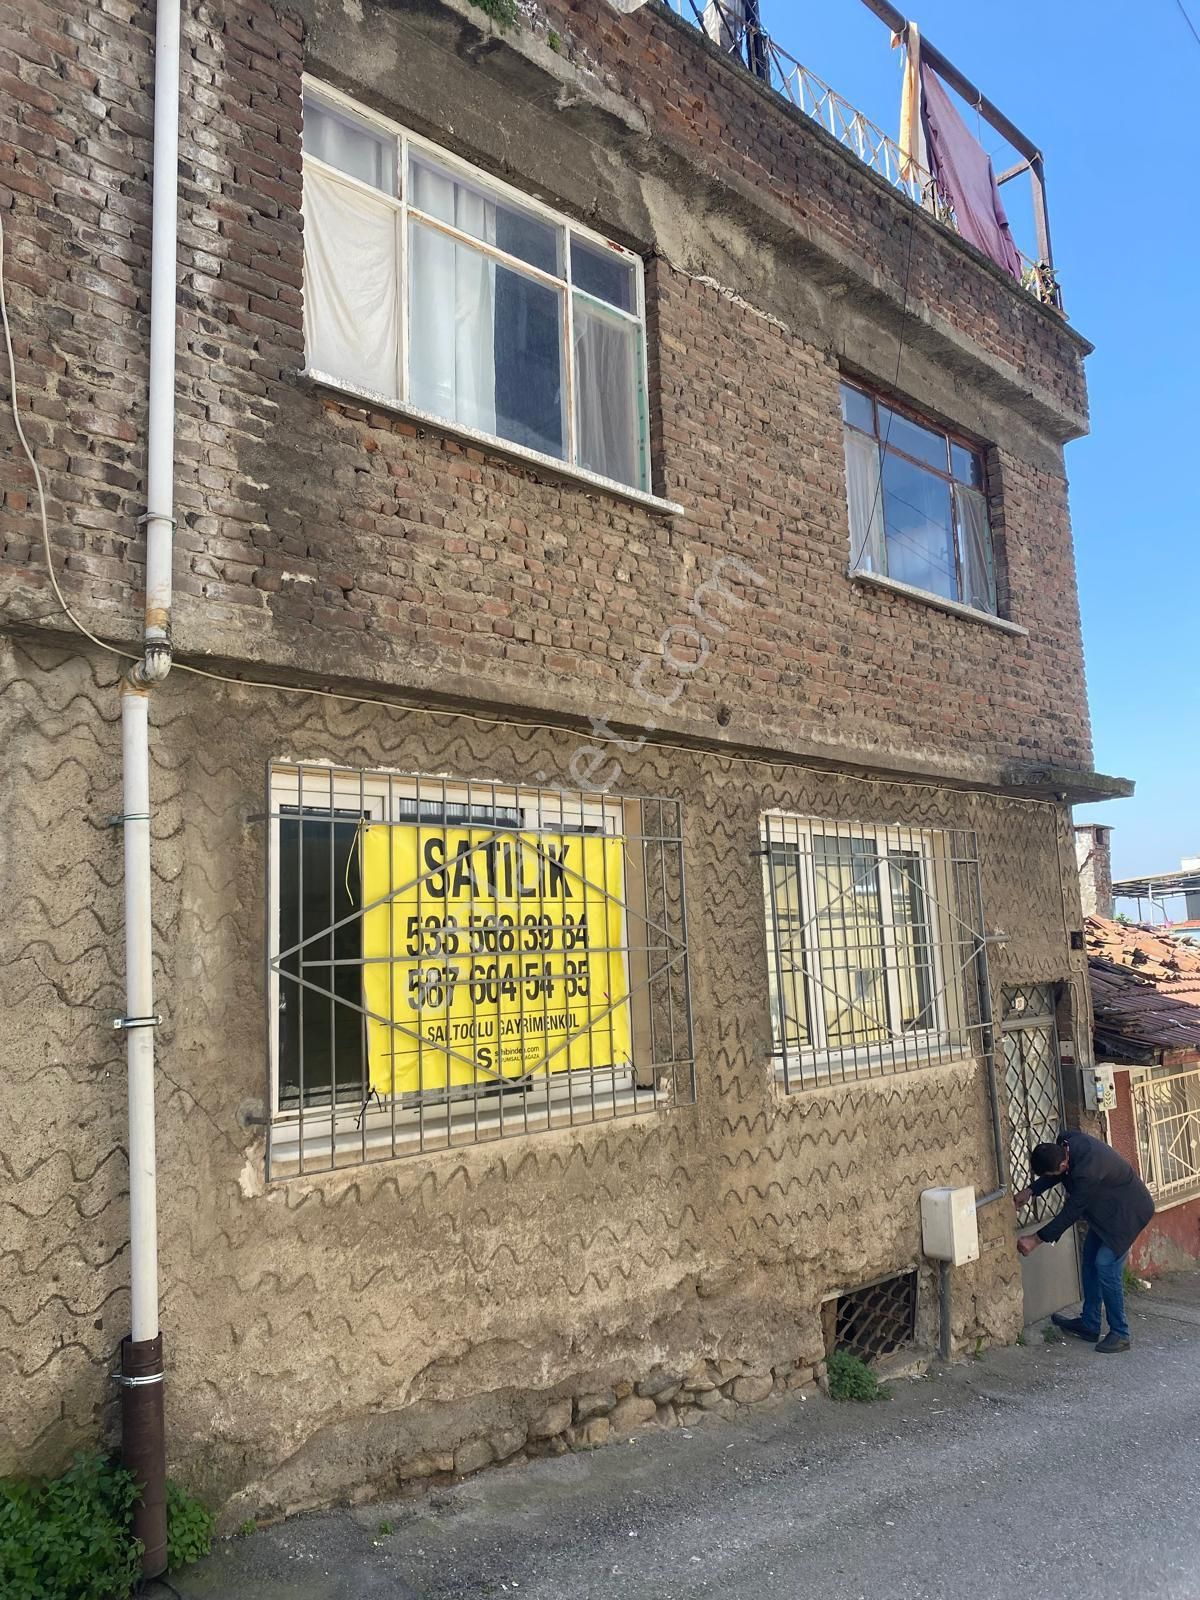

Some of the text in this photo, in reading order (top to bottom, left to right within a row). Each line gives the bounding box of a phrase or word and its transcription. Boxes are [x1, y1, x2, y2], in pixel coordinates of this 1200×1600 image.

[424, 837, 573, 898] SATILIK
[524, 913, 554, 951] 39
[469, 962, 517, 1005] 604
[525, 960, 555, 1001] 54
[477, 1047, 492, 1069] S
[494, 1046, 540, 1056] shibinden.com
